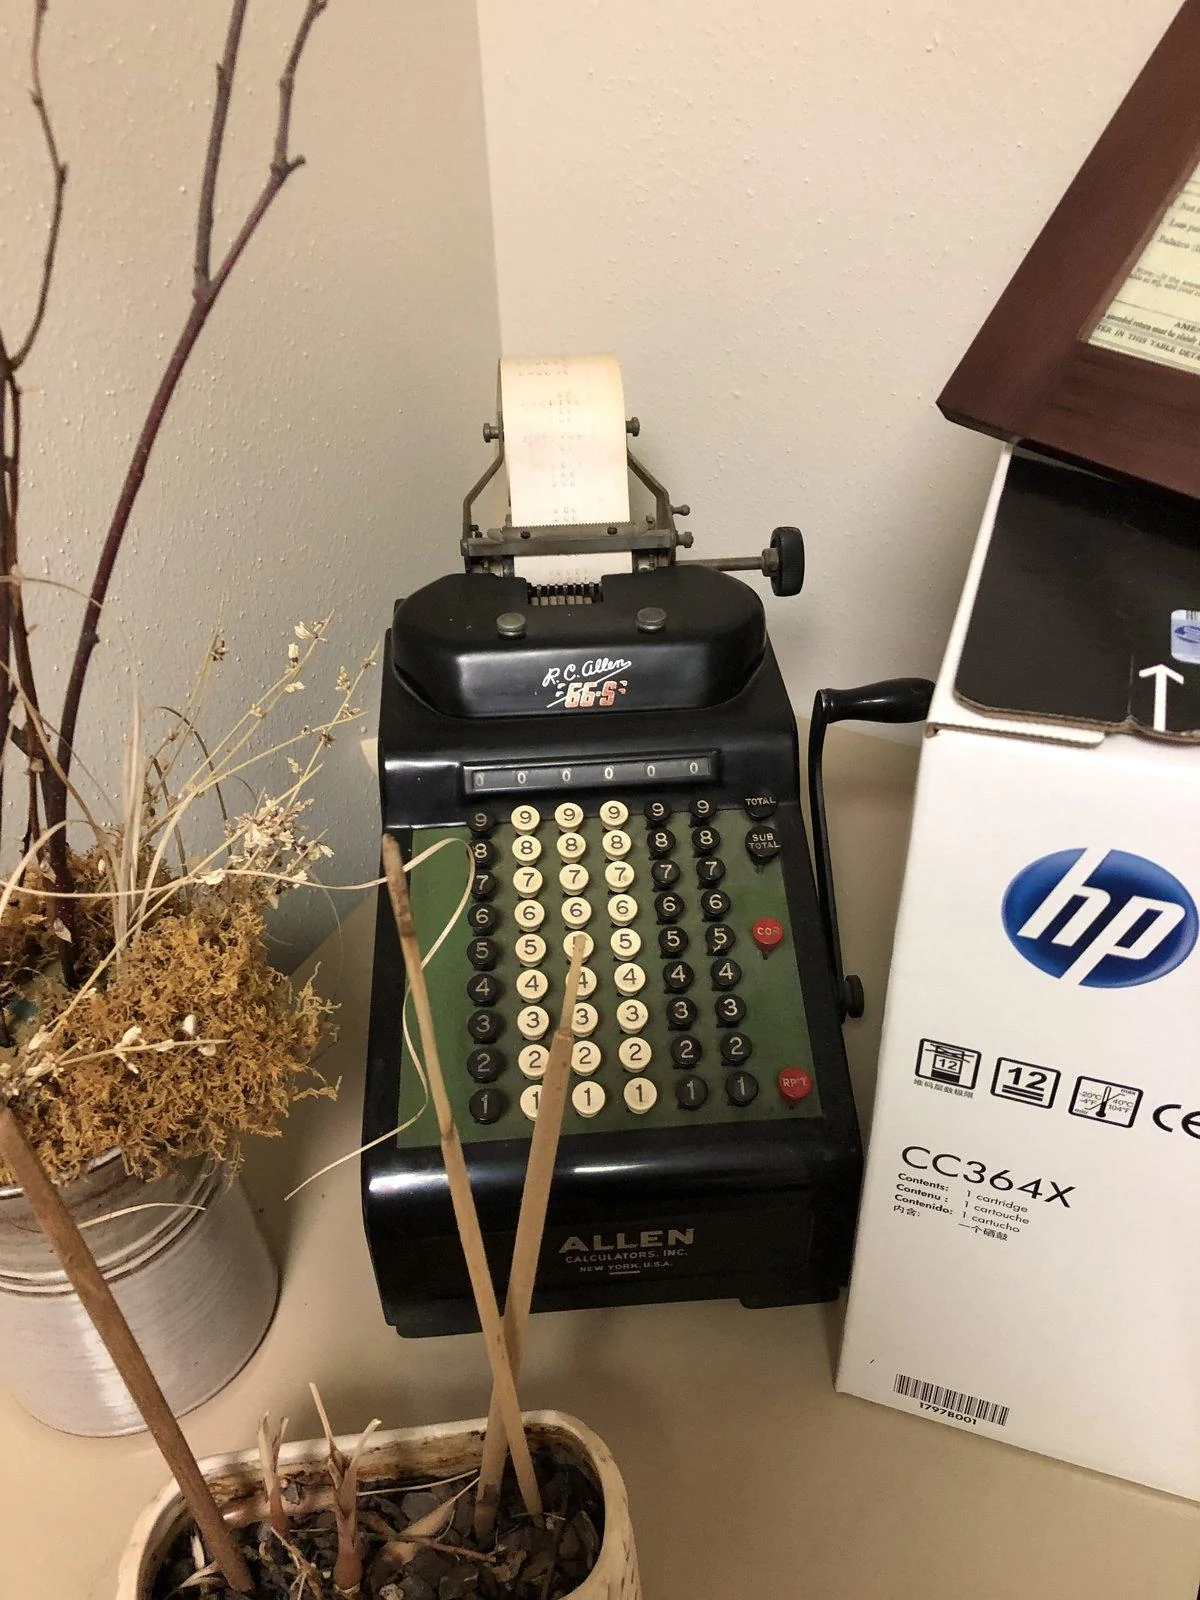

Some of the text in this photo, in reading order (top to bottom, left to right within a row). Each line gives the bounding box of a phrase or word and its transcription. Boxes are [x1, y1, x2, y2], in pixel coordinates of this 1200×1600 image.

[1128, 333, 1148, 344] THIS
[1150, 340, 1176, 353] TABLE
[475, 800, 709, 826] 9 9 9 9 9 9
[745, 797, 776, 806] TOTAL
[475, 830, 713, 858] 8 8 8 8 8 8
[749, 840, 781, 850] TOTAL
[752, 833, 774, 842] SUB
[476, 861, 717, 889] 7 7 7 7 7 7
[475, 895, 723, 923] 6 6 6 6 6 6
[1017, 847, 1186, 987] hp
[476, 928, 727, 959] 5 5 5 5 5
[475, 963, 733, 996] 4 4 4 4 4 4
[477, 998, 737, 1032] 3 3 3 3 3 3
[477, 1037, 744, 1072] 2 2 2 2 2 2
[938, 1058, 958, 1071] 12
[1008, 1067, 1048, 1092] 12
[901, 1146, 1076, 1208] CC364X
[898, 1173, 949, 1192] Contents:
[976, 1195, 1028, 1213] cartridge
[894, 1194, 954, 1215] Contenido:
[971, 1215, 1020, 1233] cartucho
[974, 1205, 1030, 1224] cartouche
[559, 1228, 695, 1253] ALLEN
[919, 1402, 978, 1426] 1797B001
